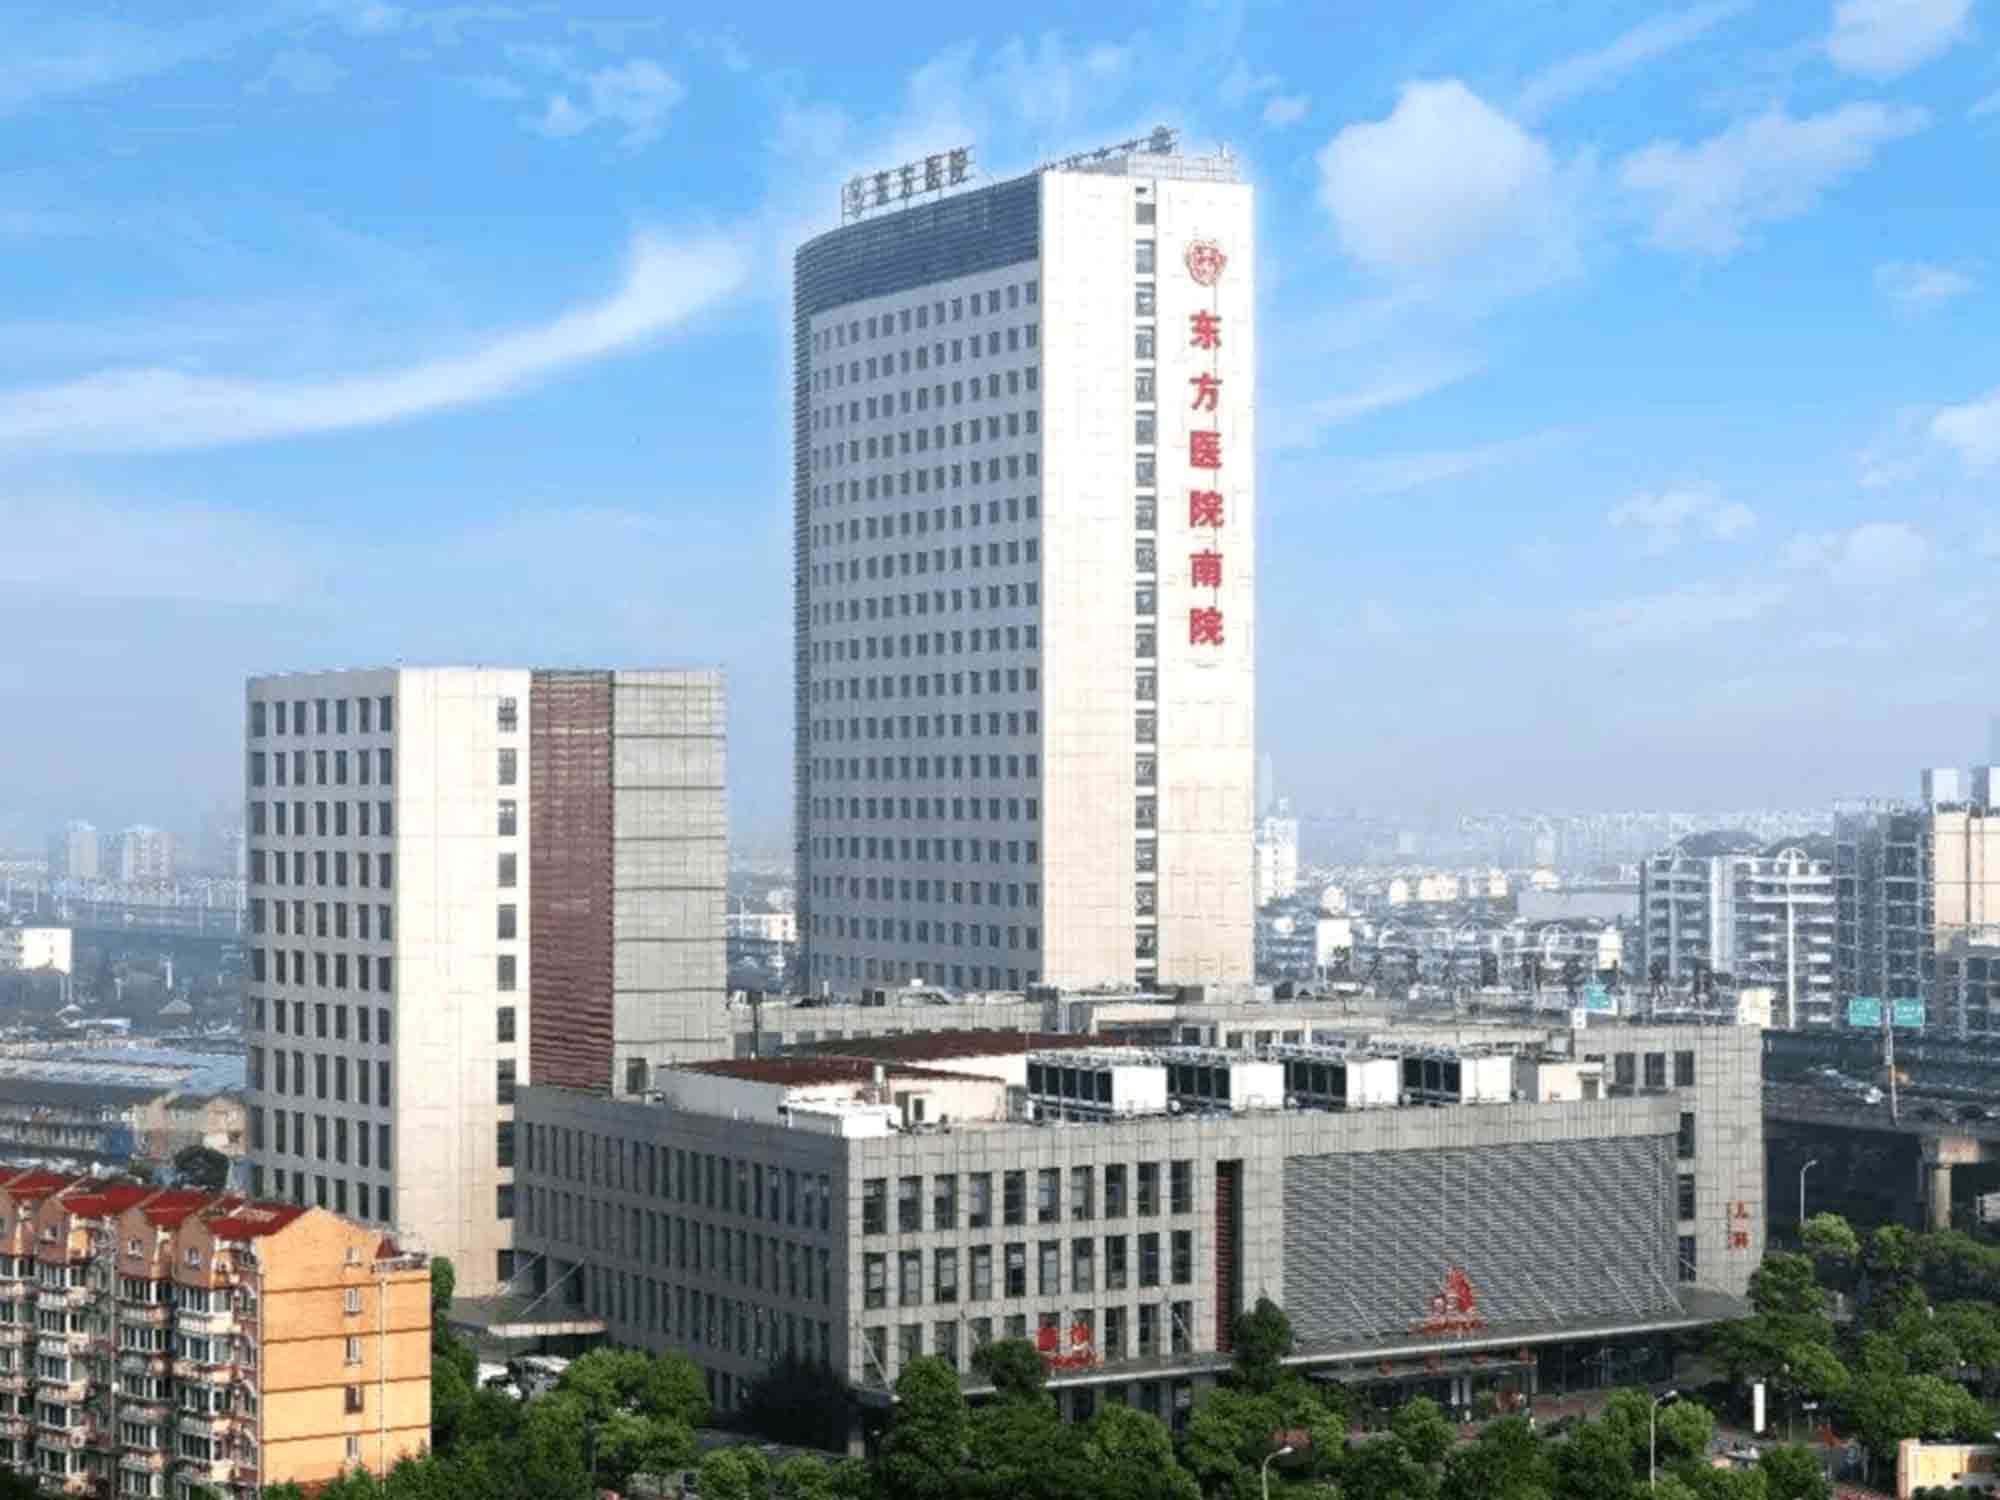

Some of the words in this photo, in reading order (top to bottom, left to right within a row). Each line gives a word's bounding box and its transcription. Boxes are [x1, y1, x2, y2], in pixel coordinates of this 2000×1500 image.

[1189, 310, 1224, 645] 东方医院南院
